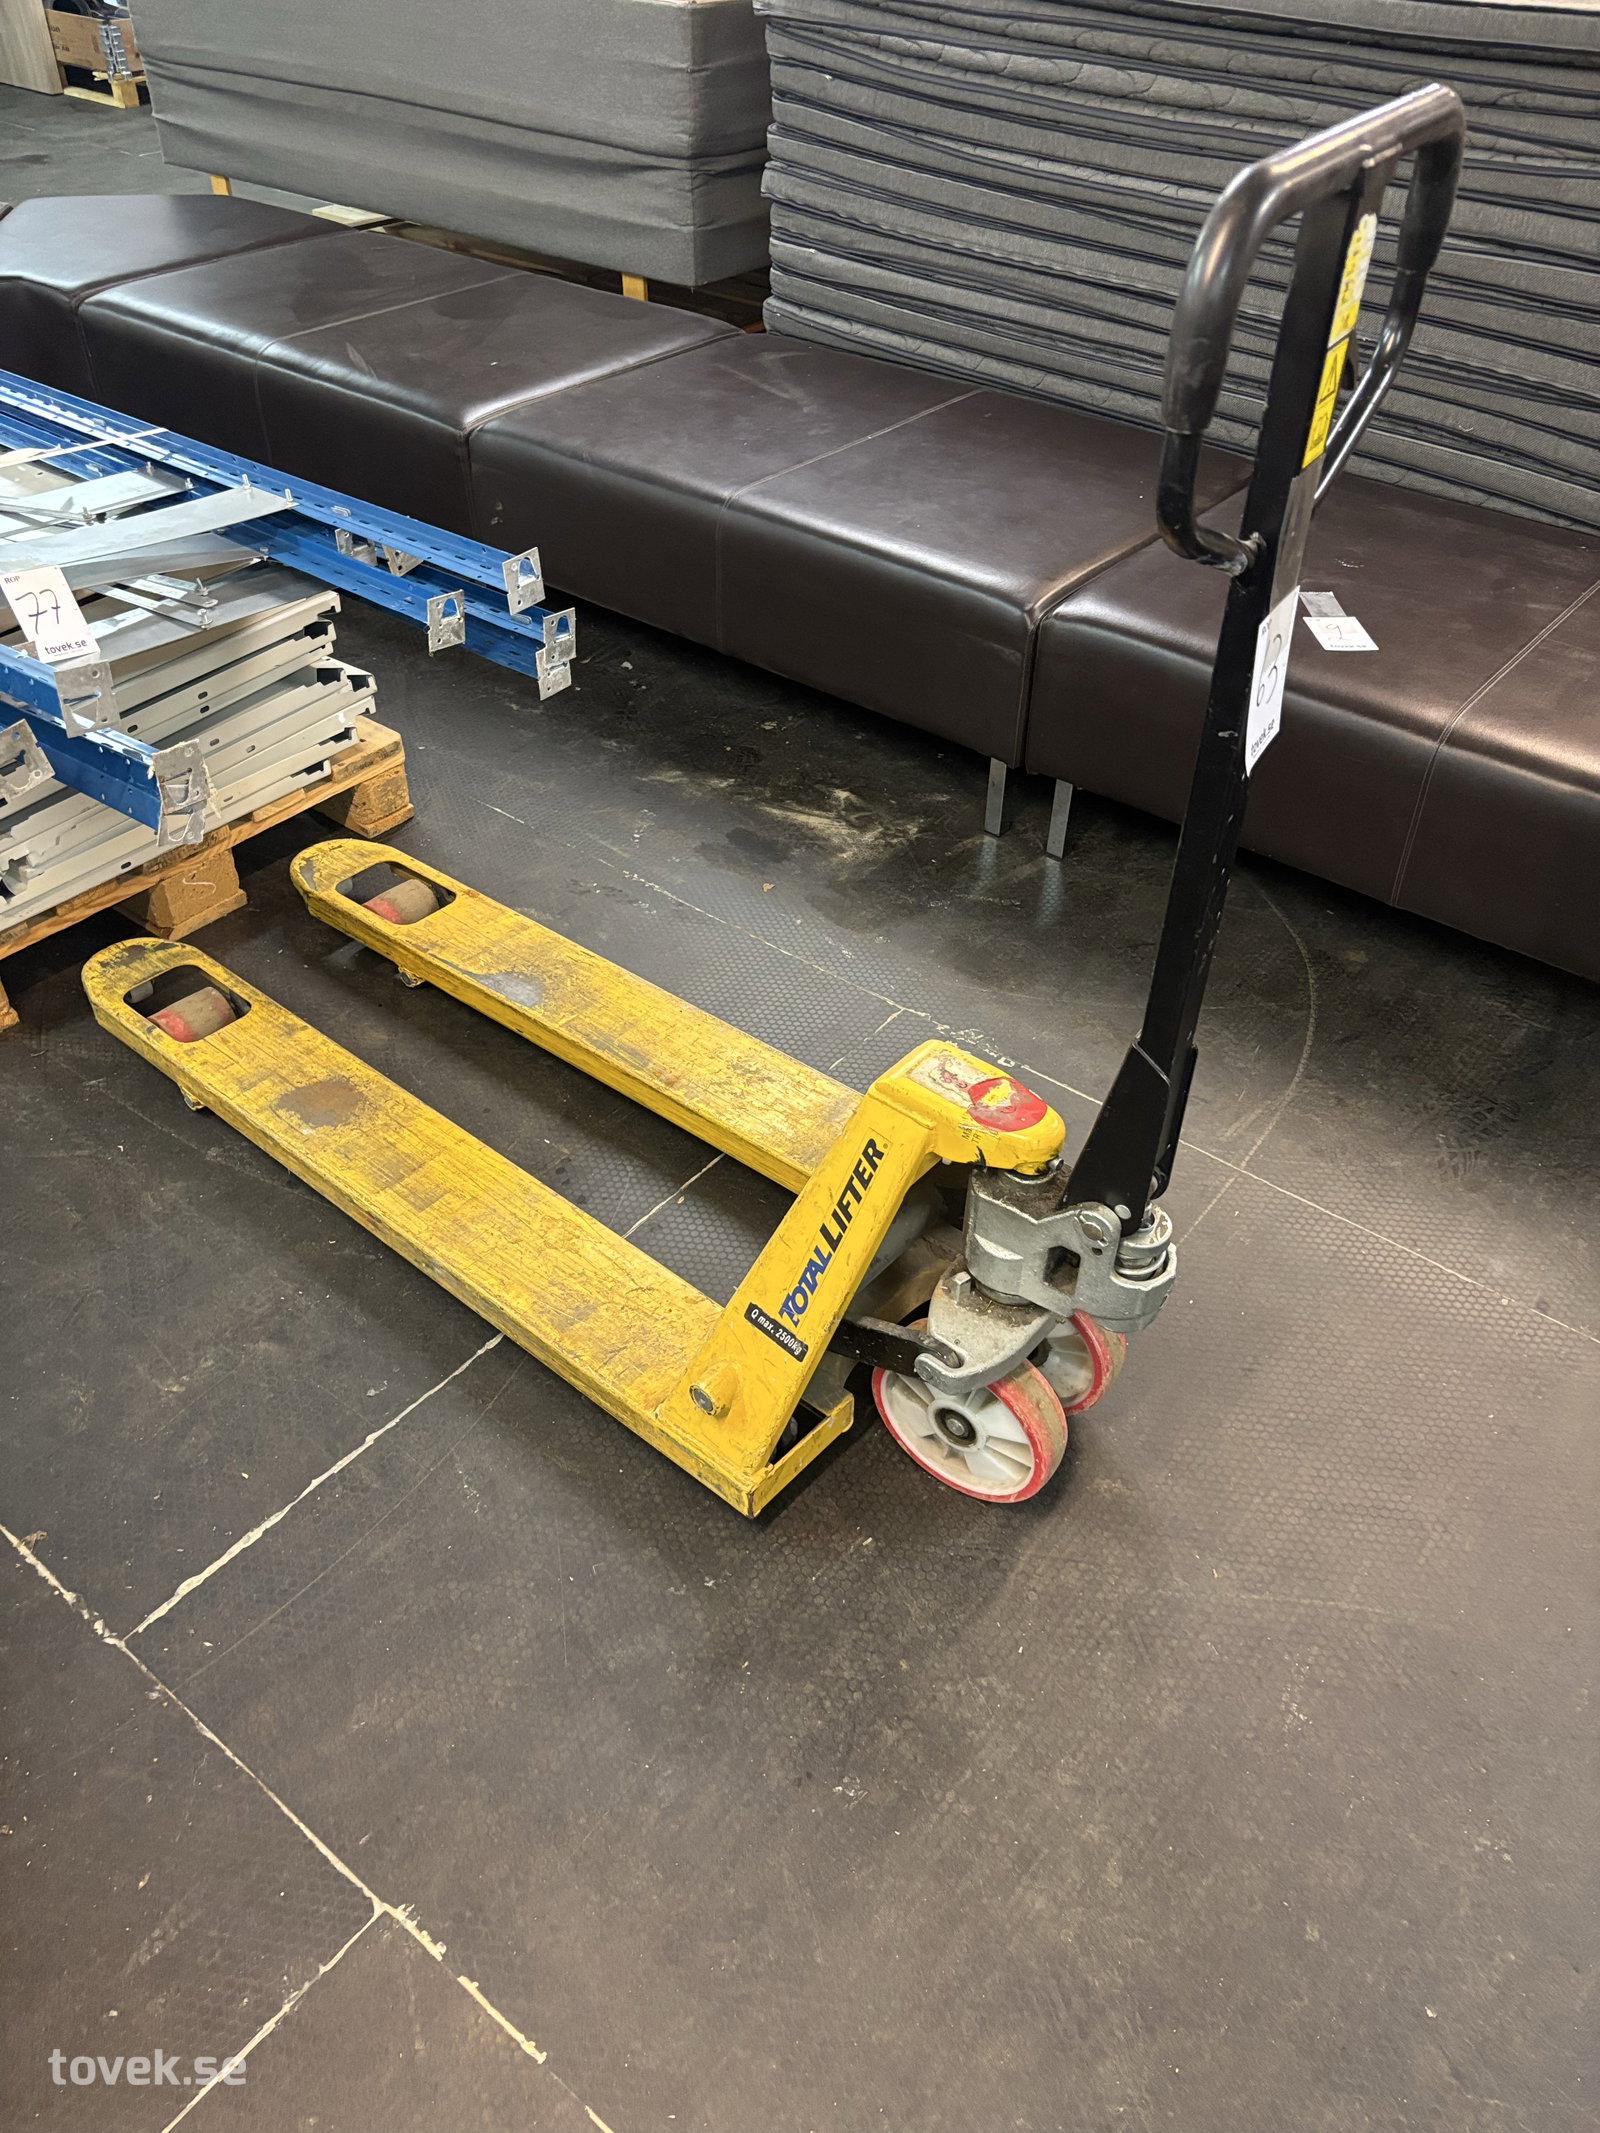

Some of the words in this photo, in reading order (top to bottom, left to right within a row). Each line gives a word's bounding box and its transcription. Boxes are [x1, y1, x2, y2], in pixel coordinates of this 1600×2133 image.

[4, 575, 20, 584] ROP
[15, 588, 61, 634] 77
[44, 639, 87, 654] tovek.se
[751, 1309, 759, 1319] Q
[757, 1315, 774, 1333] max.
[775, 1328, 802, 1355] 2500kg
